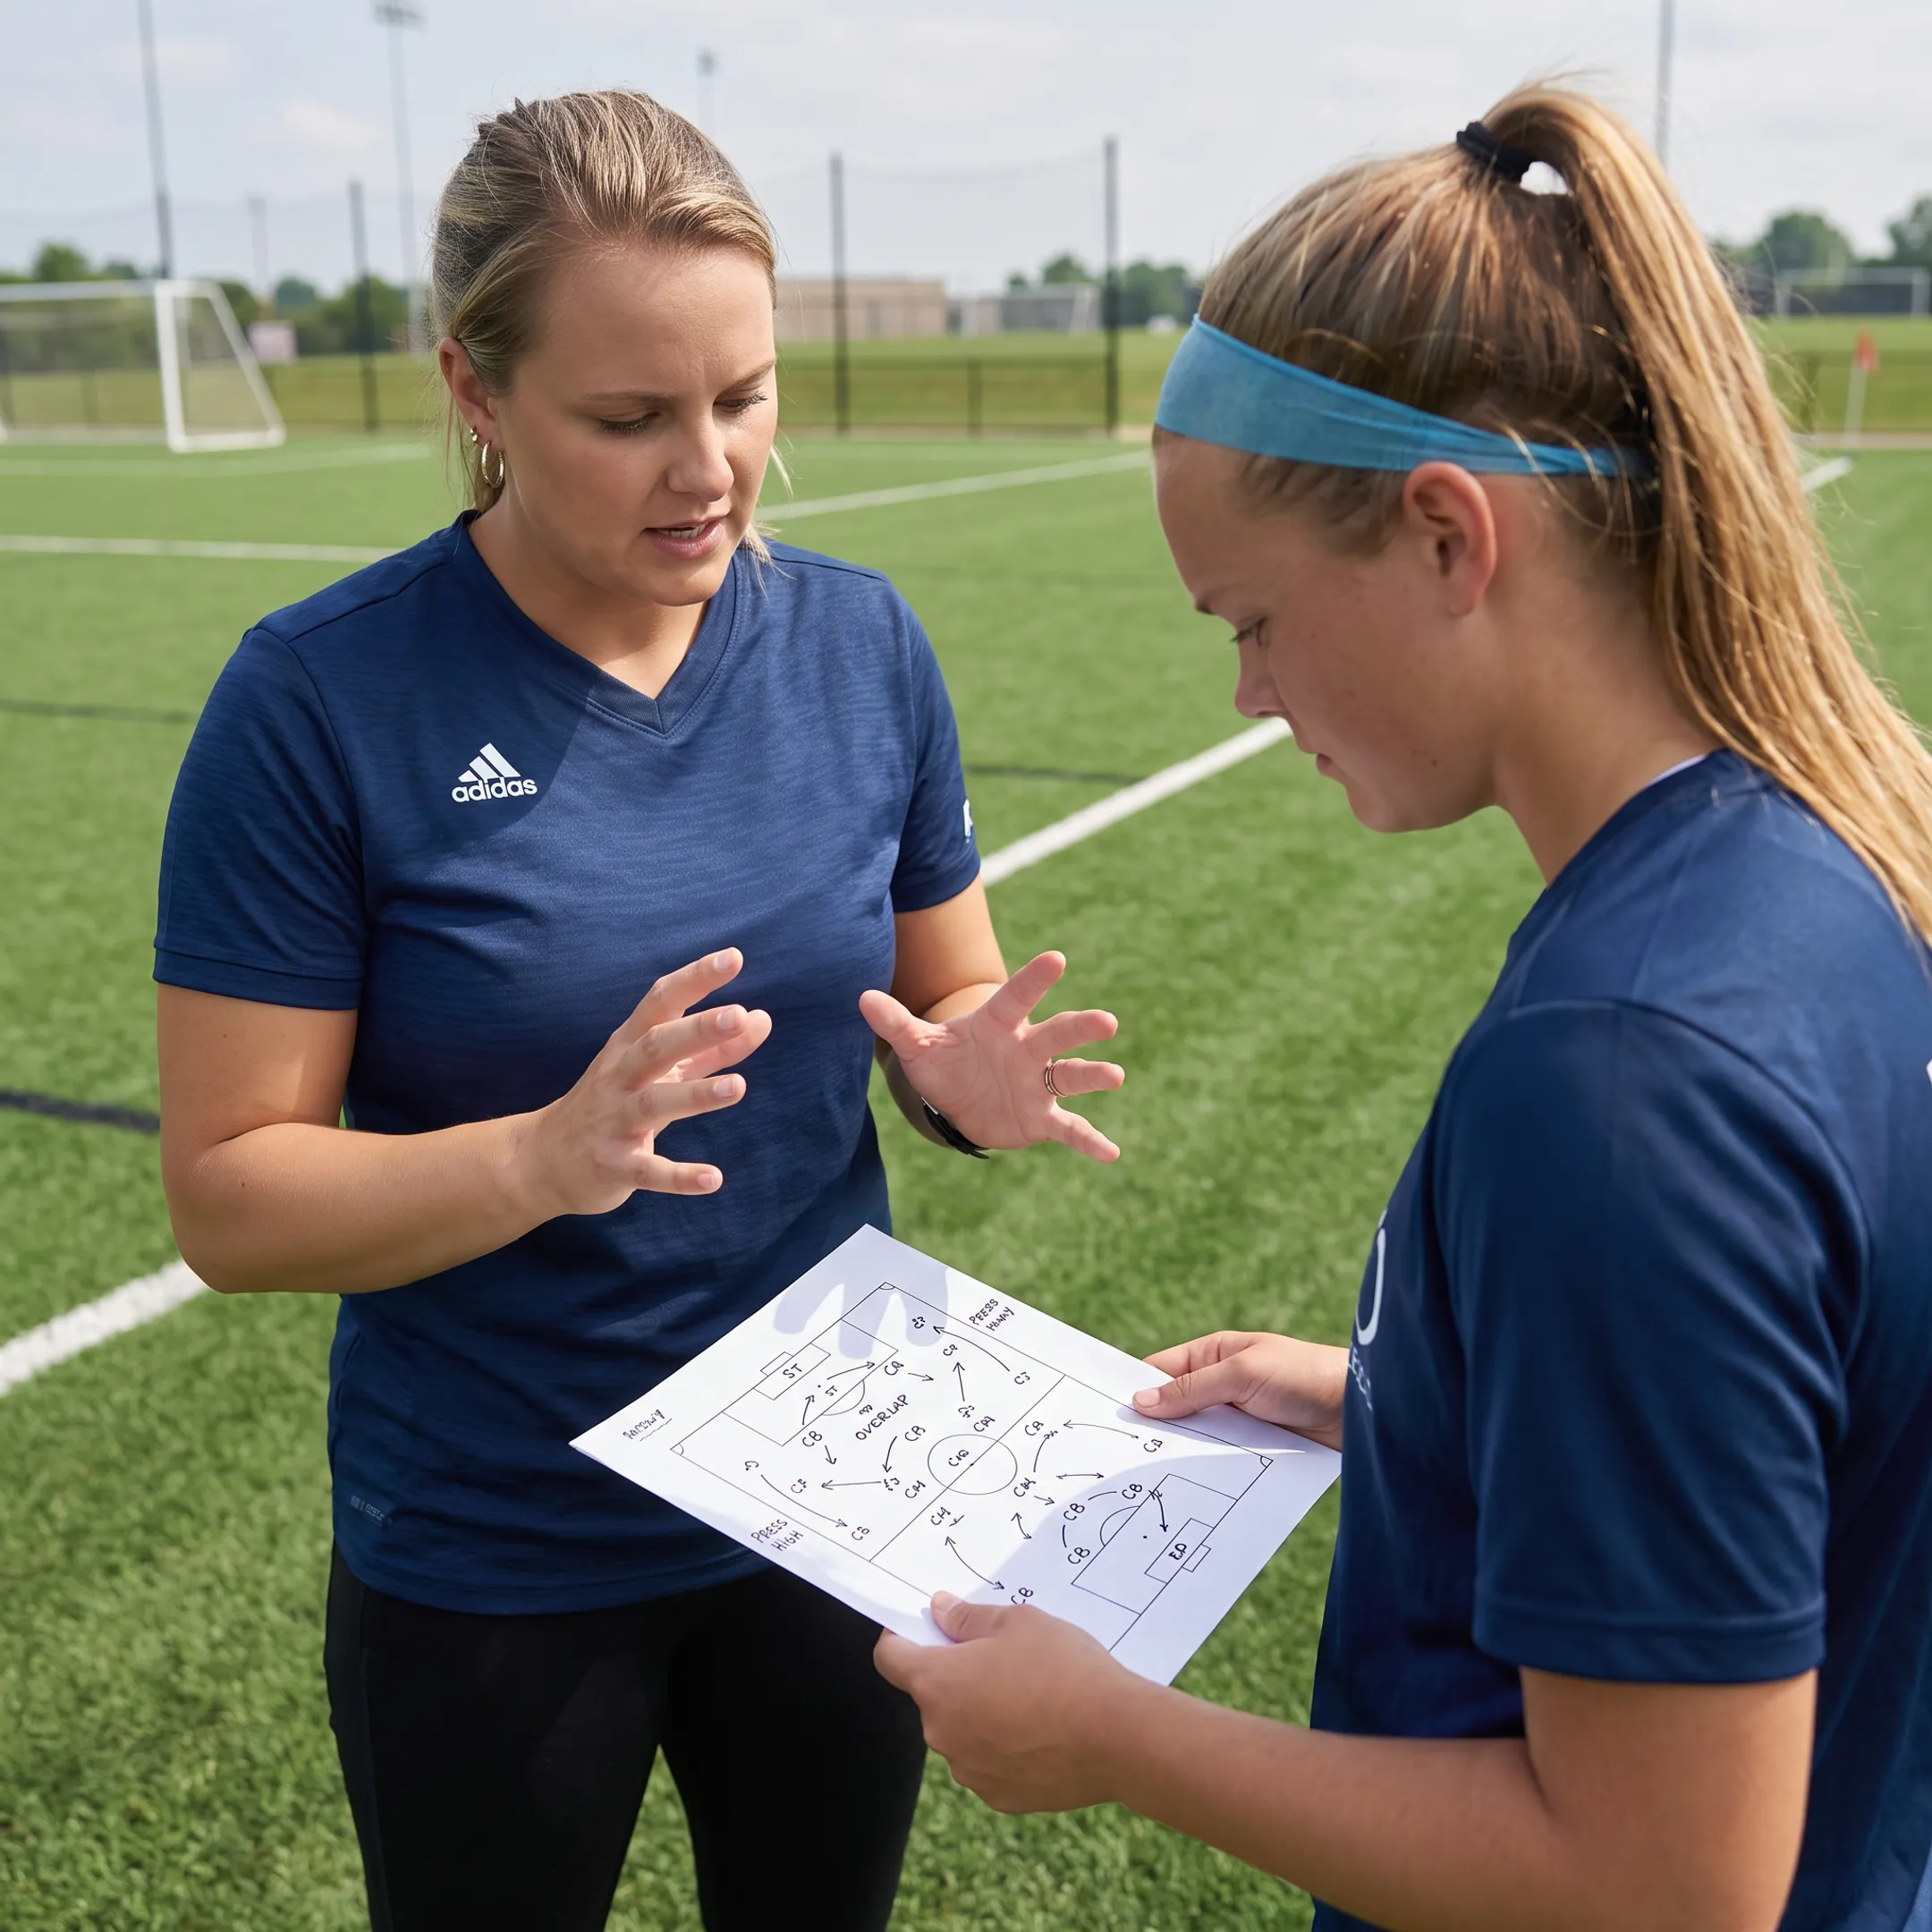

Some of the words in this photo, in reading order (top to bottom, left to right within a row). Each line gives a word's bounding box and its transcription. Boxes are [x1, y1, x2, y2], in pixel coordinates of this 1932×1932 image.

[452, 776, 538, 802] adidas
[783, 1363, 802, 1379] ST
[825, 1385, 838, 1396] ST
[855, 1394, 909, 1441] OVERLAP
[802, 1430, 823, 1447] CB
[1122, 1483, 1143, 1499] CB
[1063, 1503, 1085, 1521] CB
[751, 1519, 788, 1544] PRESS
[771, 1530, 804, 1551] HIGH
[1067, 1546, 1090, 1564] CB
[1011, 1587, 1033, 1605] CB
